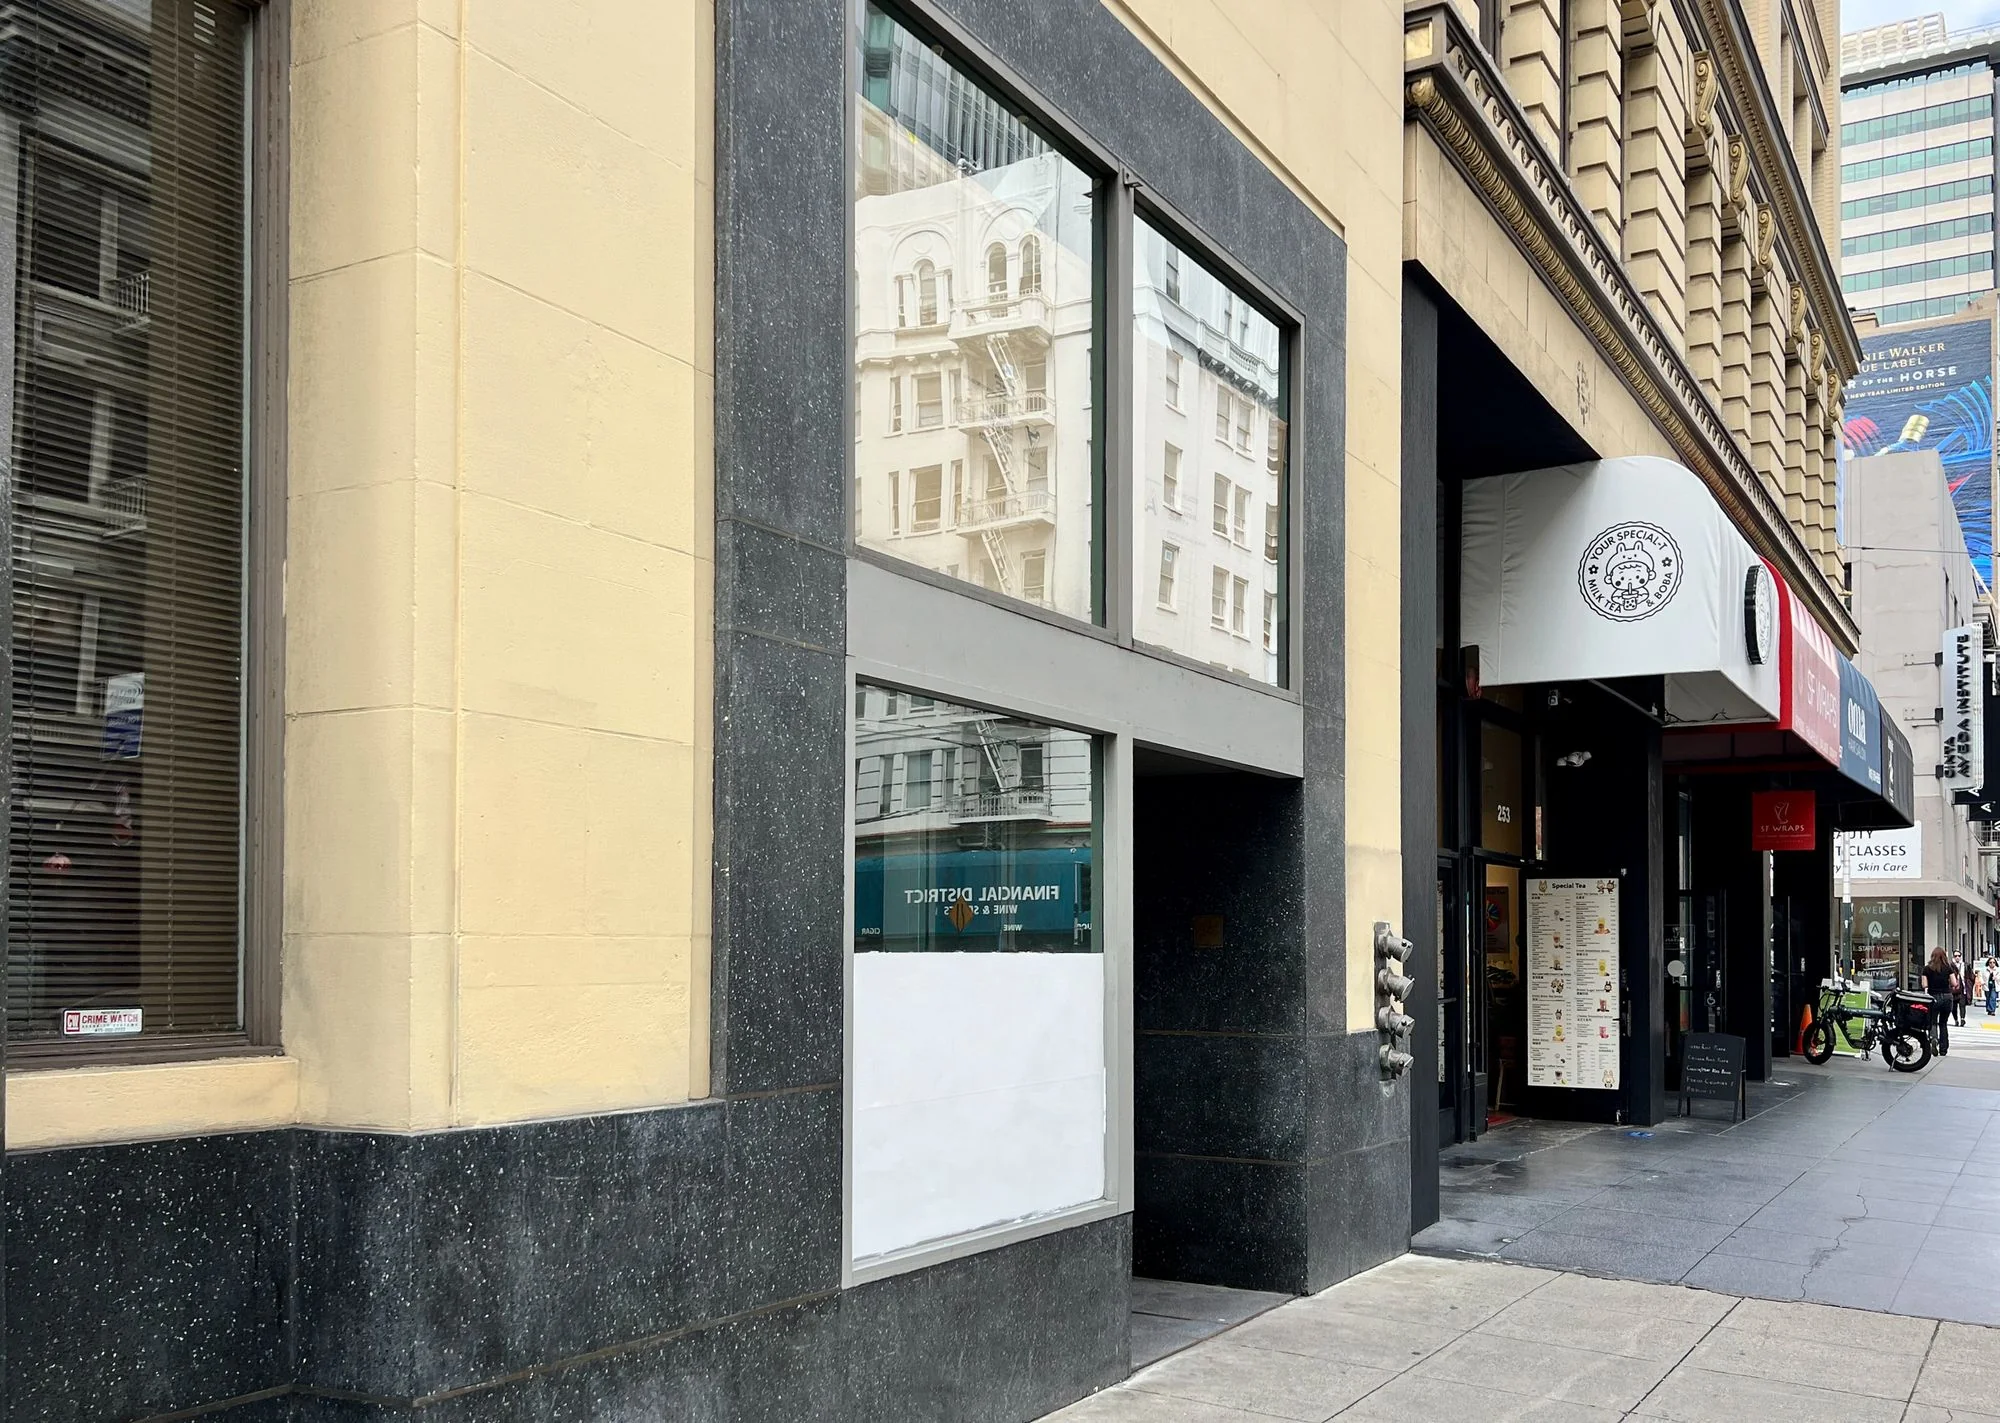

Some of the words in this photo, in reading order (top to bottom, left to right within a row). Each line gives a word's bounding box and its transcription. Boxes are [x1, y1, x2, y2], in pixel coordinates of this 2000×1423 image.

[1889, 342, 1945, 358] WALKER
[1884, 357, 1925, 370] LABEL
[1900, 366, 1957, 383] HORSE
[1887, 386, 1914, 394] LIMITED
[1916, 382, 1945, 390] EDITION
[1590, 536, 1616, 560] YOUR
[1616, 529, 1668, 551] SPECIAL-T
[1587, 578, 1605, 603] MILK
[1604, 599, 1621, 613] TEA
[1646, 599, 1655, 607] &
[1653, 572, 1673, 600] BOBA
[1956, 634, 1971, 714] INSTITUTE
[1816, 679, 1837, 729] WRAPS
[1957, 718, 1971, 778] AVEDA
[1497, 804, 1511, 824] 253
[1772, 824, 1805, 832] WRAPS
[1849, 845, 1906, 857] CLASSES
[1857, 862, 1880, 872] Skin
[1883, 862, 1908, 872] Care
[1859, 906, 1892, 915] AVEDA
[82, 1015, 107, 1024] CRIME
[110, 1013, 138, 1023] WATCH
